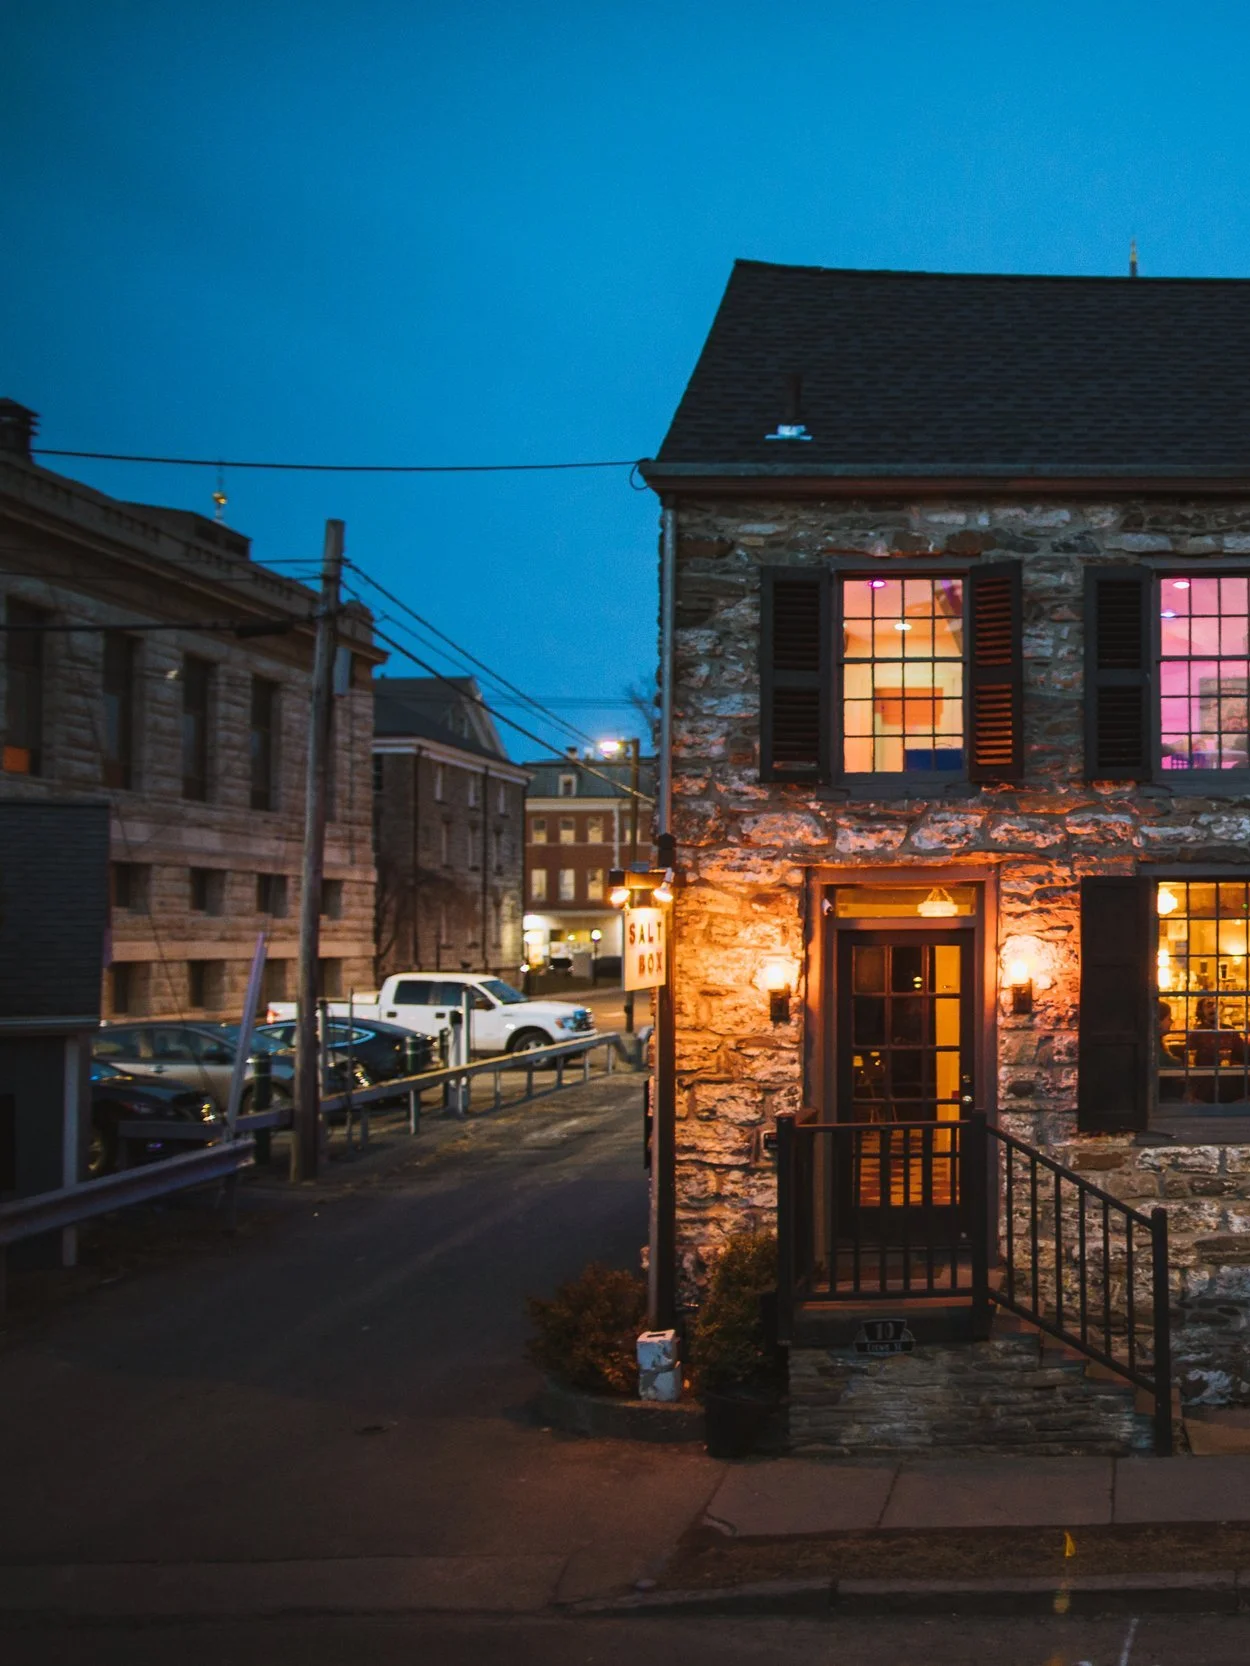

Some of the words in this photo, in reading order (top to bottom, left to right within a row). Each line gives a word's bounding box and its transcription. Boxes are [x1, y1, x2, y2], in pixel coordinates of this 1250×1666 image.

[629, 921, 662, 946] SALT
[639, 951, 663, 977] BOX
[875, 1322, 895, 1340] 10
